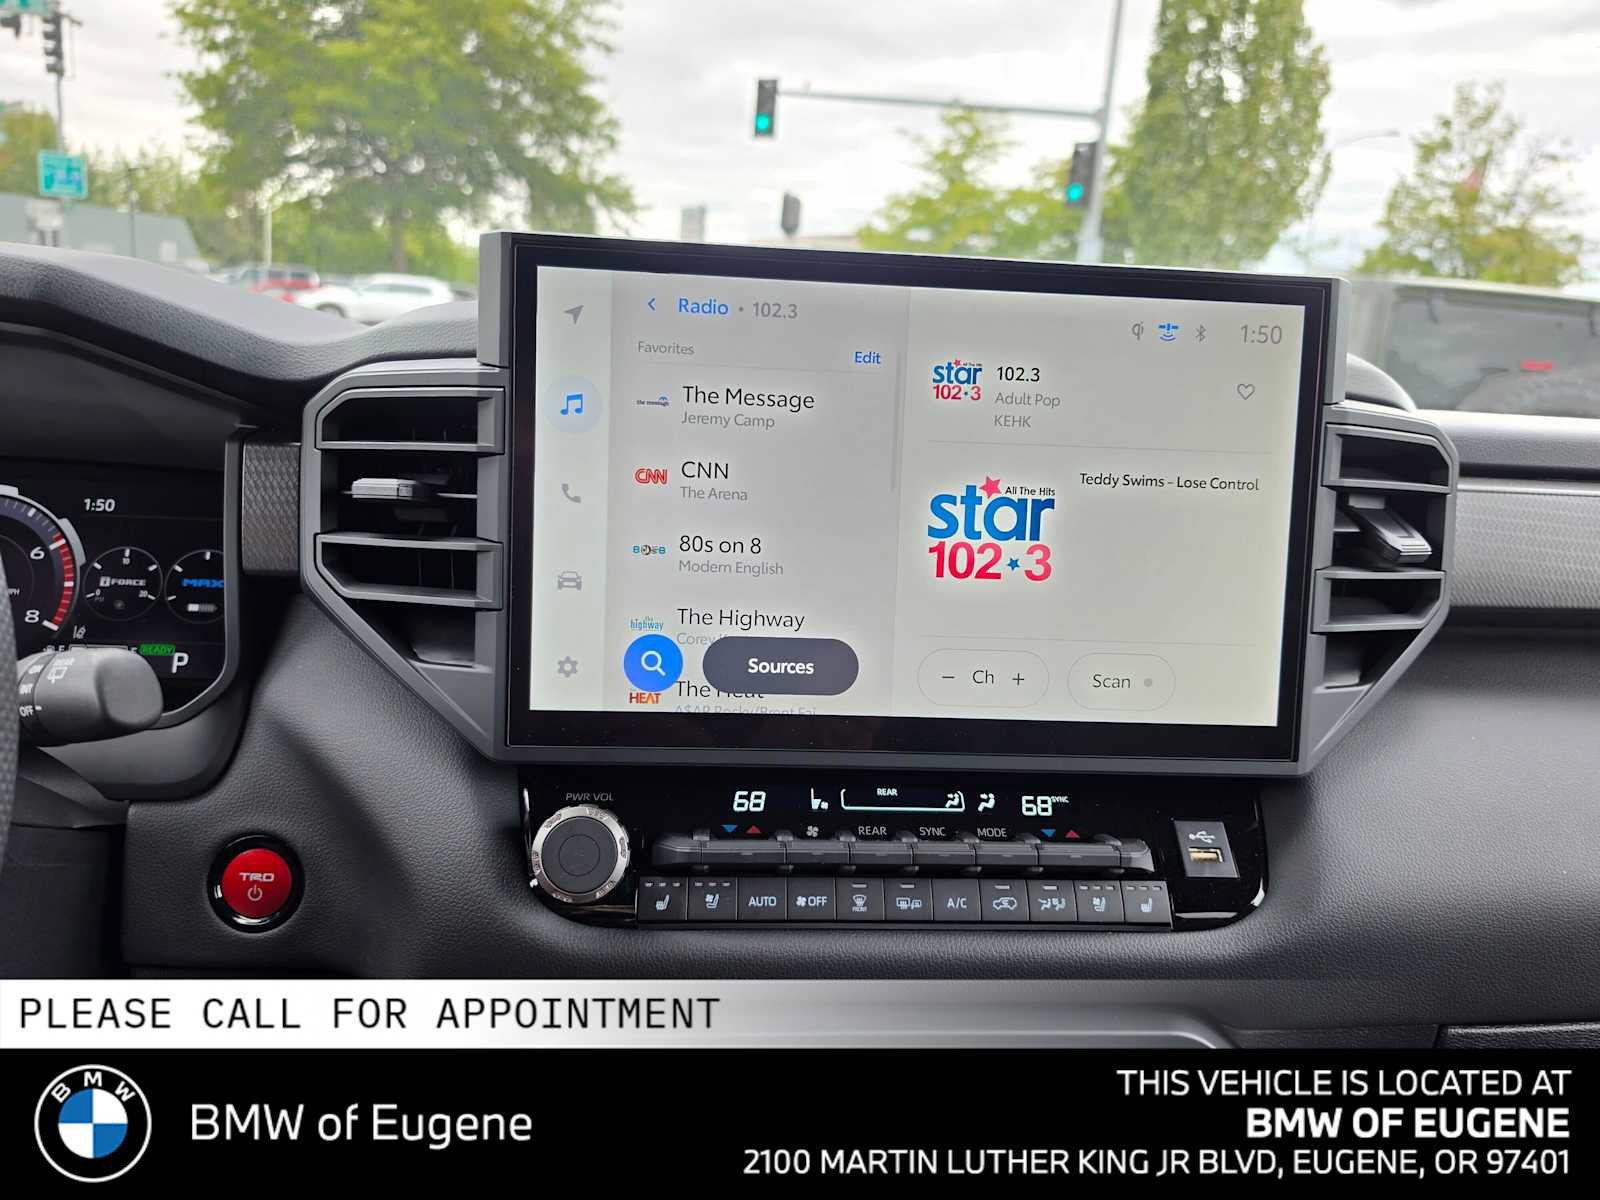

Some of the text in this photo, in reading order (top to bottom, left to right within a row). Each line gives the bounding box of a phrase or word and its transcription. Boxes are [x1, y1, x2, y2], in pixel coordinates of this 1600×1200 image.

[678, 298, 798, 319] Radio 102.3
[1240, 325, 1282, 345] 1:50
[638, 341, 695, 355] Favorites
[854, 352, 881, 365] Edit
[933, 361, 982, 384] star
[997, 366, 1040, 382] 102.3
[682, 386, 815, 413] The Message
[995, 392, 1061, 409] Adult Pop
[681, 411, 775, 429] Jeremy Camp
[994, 415, 1031, 428] KEHK
[634, 468, 668, 485] CNN
[681, 461, 729, 480] CNN
[1080, 473, 1119, 488] Teddy
[1122, 474, 1165, 488] Swims
[1177, 476, 1207, 489] Lose
[1210, 477, 1259, 491] Control
[681, 487, 748, 501] The Arena
[1005, 486, 1056, 497] All The Hits
[84, 498, 115, 512] 1:50
[928, 484, 1056, 541] star
[679, 535, 762, 554] 80s on 8
[30, 546, 45, 559] 6
[679, 560, 784, 576] Modern English
[25, 609, 39, 623] 8
[677, 608, 805, 631] The Highway
[630, 619, 664, 632] highway
[172, 652, 189, 674] P
[748, 658, 815, 675] Sources
[972, 670, 994, 685] Ch
[1092, 674, 1131, 689] Scan
[676, 680, 711, 698] The
[629, 692, 662, 704] HEAT
[19, 705, 34, 717] OFF
[565, 793, 614, 801] PWR VOL
[876, 788, 898, 797] REAR
[733, 791, 766, 812] 68
[1022, 796, 1052, 816] 68
[858, 826, 887, 837] REAR
[919, 827, 946, 837] SYNC
[977, 828, 1007, 838] MODE
[239, 872, 275, 882] TRD
[748, 896, 777, 907] AUTO
[808, 896, 827, 907] OFF
[947, 898, 967, 909] A/C
